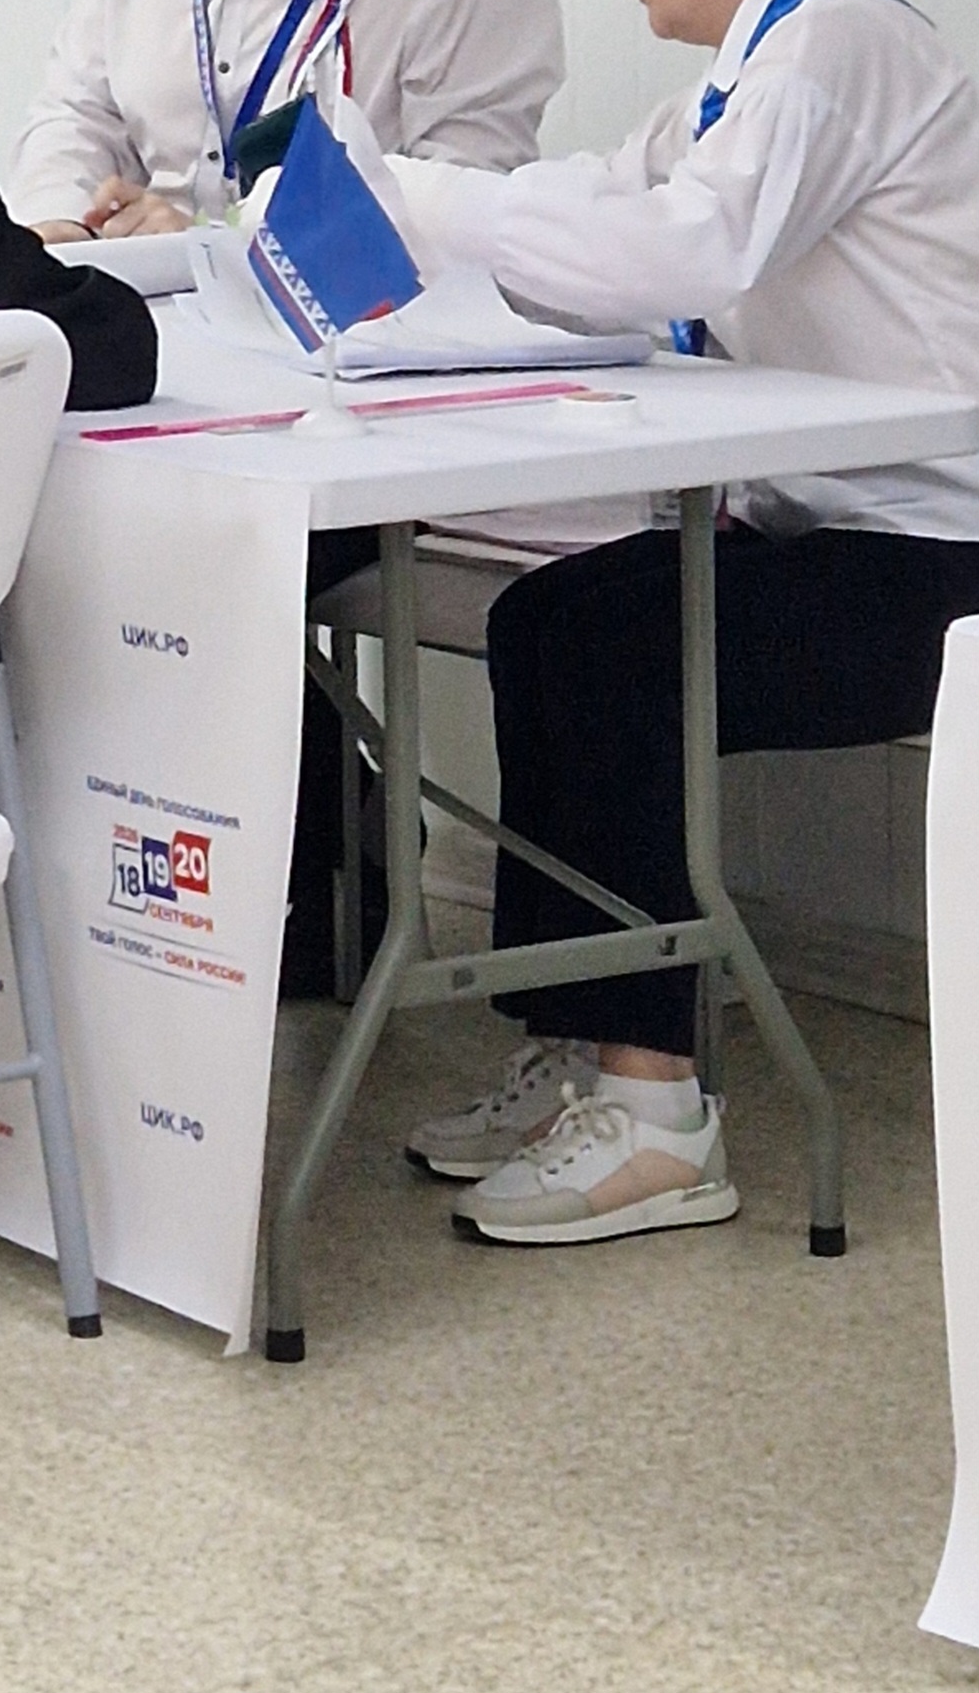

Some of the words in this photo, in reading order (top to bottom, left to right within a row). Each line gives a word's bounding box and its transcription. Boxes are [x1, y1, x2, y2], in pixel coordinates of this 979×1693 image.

[121, 623, 189, 658] ЦИК.РФ
[117, 862, 140, 897] 18
[144, 850, 170, 888] 19
[174, 842, 206, 881] 20
[140, 1102, 204, 1142] ЦИК.РФ
